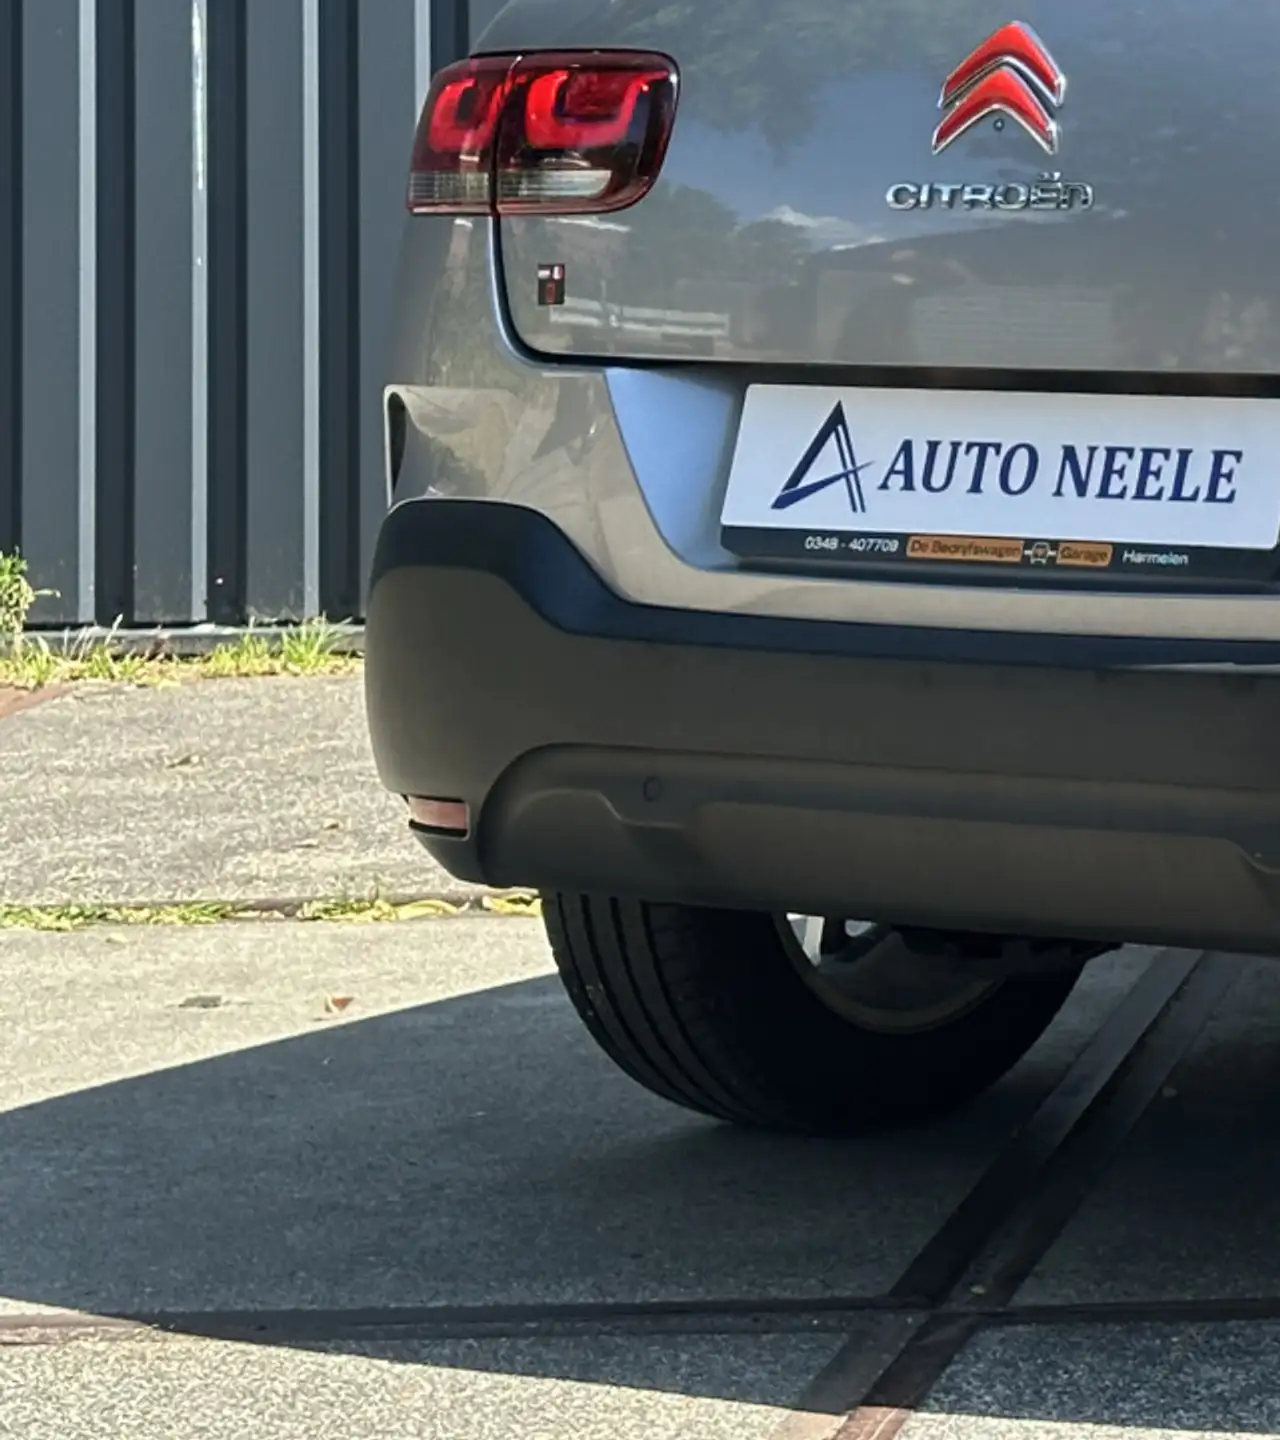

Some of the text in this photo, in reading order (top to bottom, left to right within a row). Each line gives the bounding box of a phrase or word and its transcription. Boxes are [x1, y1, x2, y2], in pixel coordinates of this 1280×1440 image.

[877, 439, 1244, 505] AUTO NEELE
[804, 535, 838, 550] 0348
[1060, 545, 1110, 563] Garage
[1122, 549, 1190, 566] Harmelen
